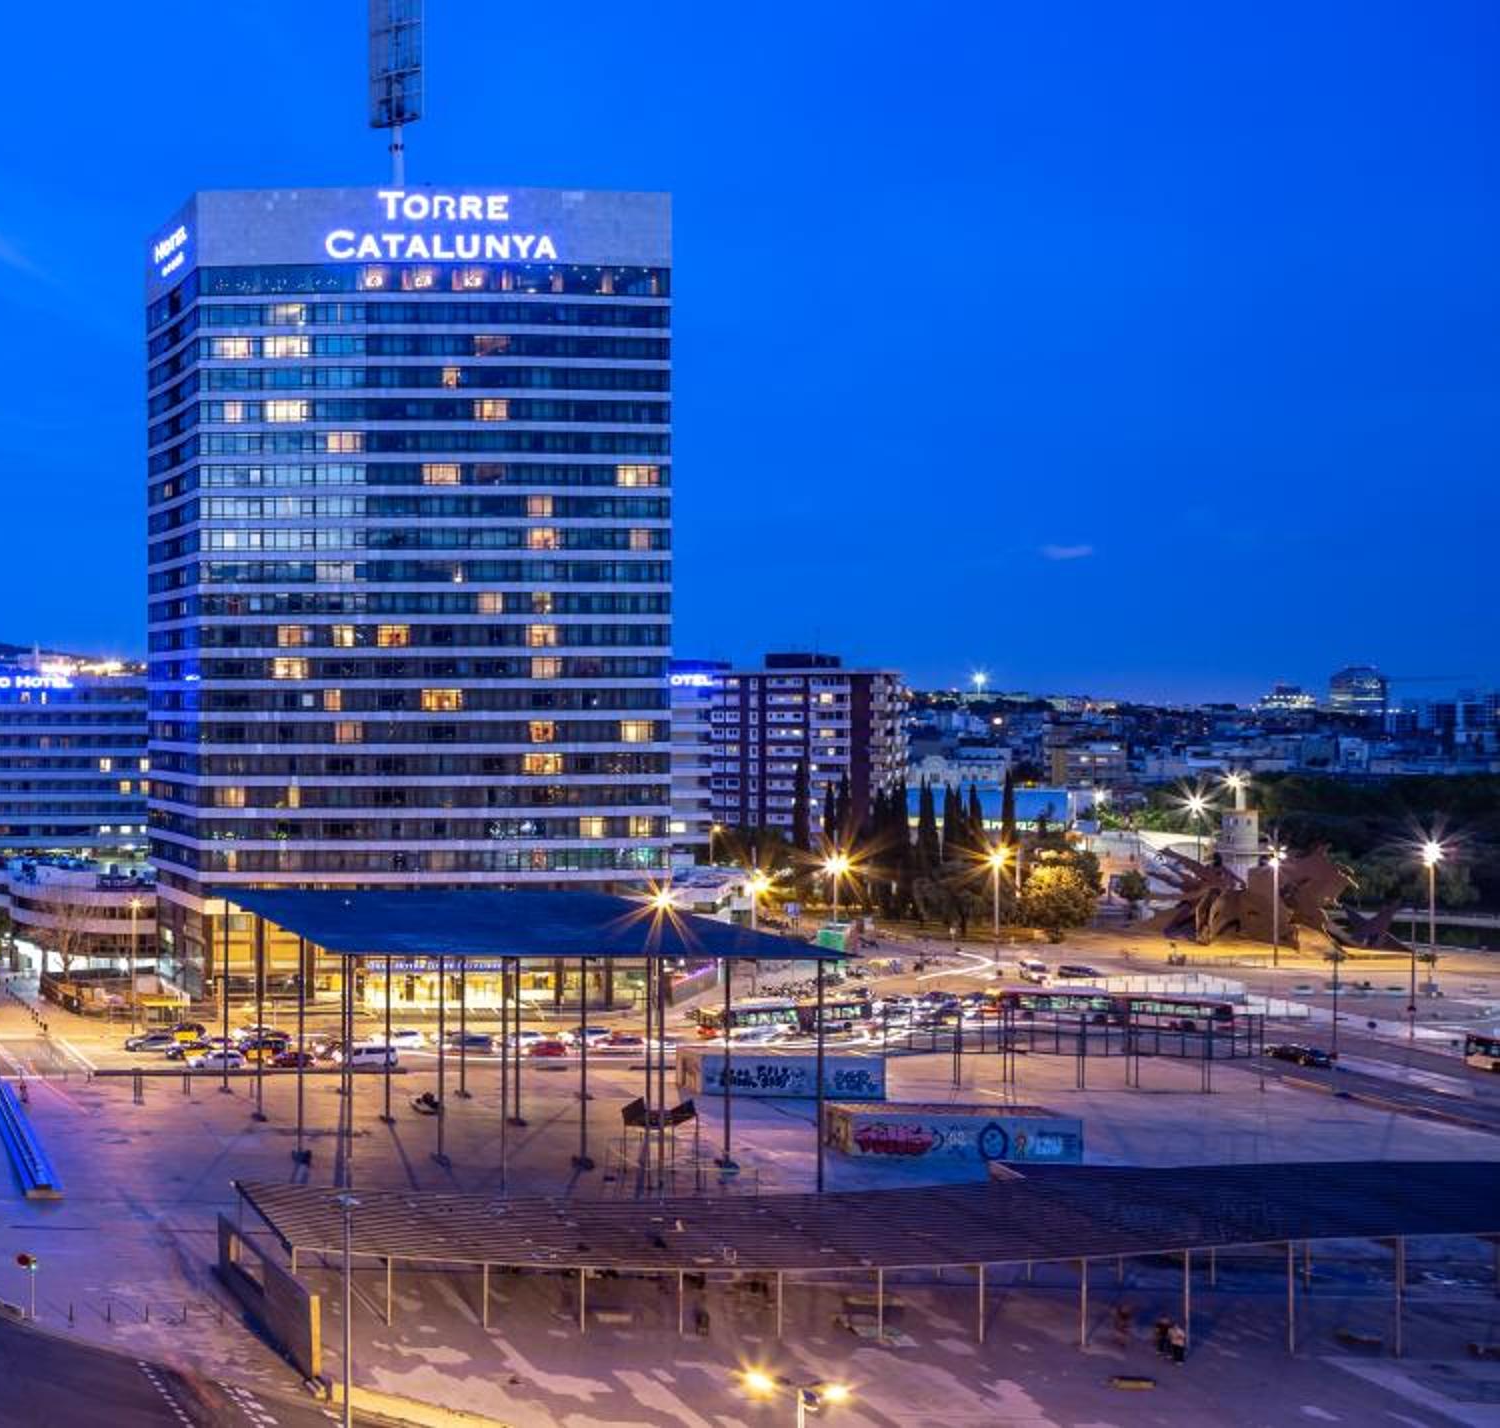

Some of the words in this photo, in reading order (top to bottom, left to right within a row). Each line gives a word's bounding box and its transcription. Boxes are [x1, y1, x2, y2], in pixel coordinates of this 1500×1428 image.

[377, 190, 509, 221] TORRE
[324, 229, 558, 260] CATALUNYA
[15, 675, 74, 689] HOTEL
